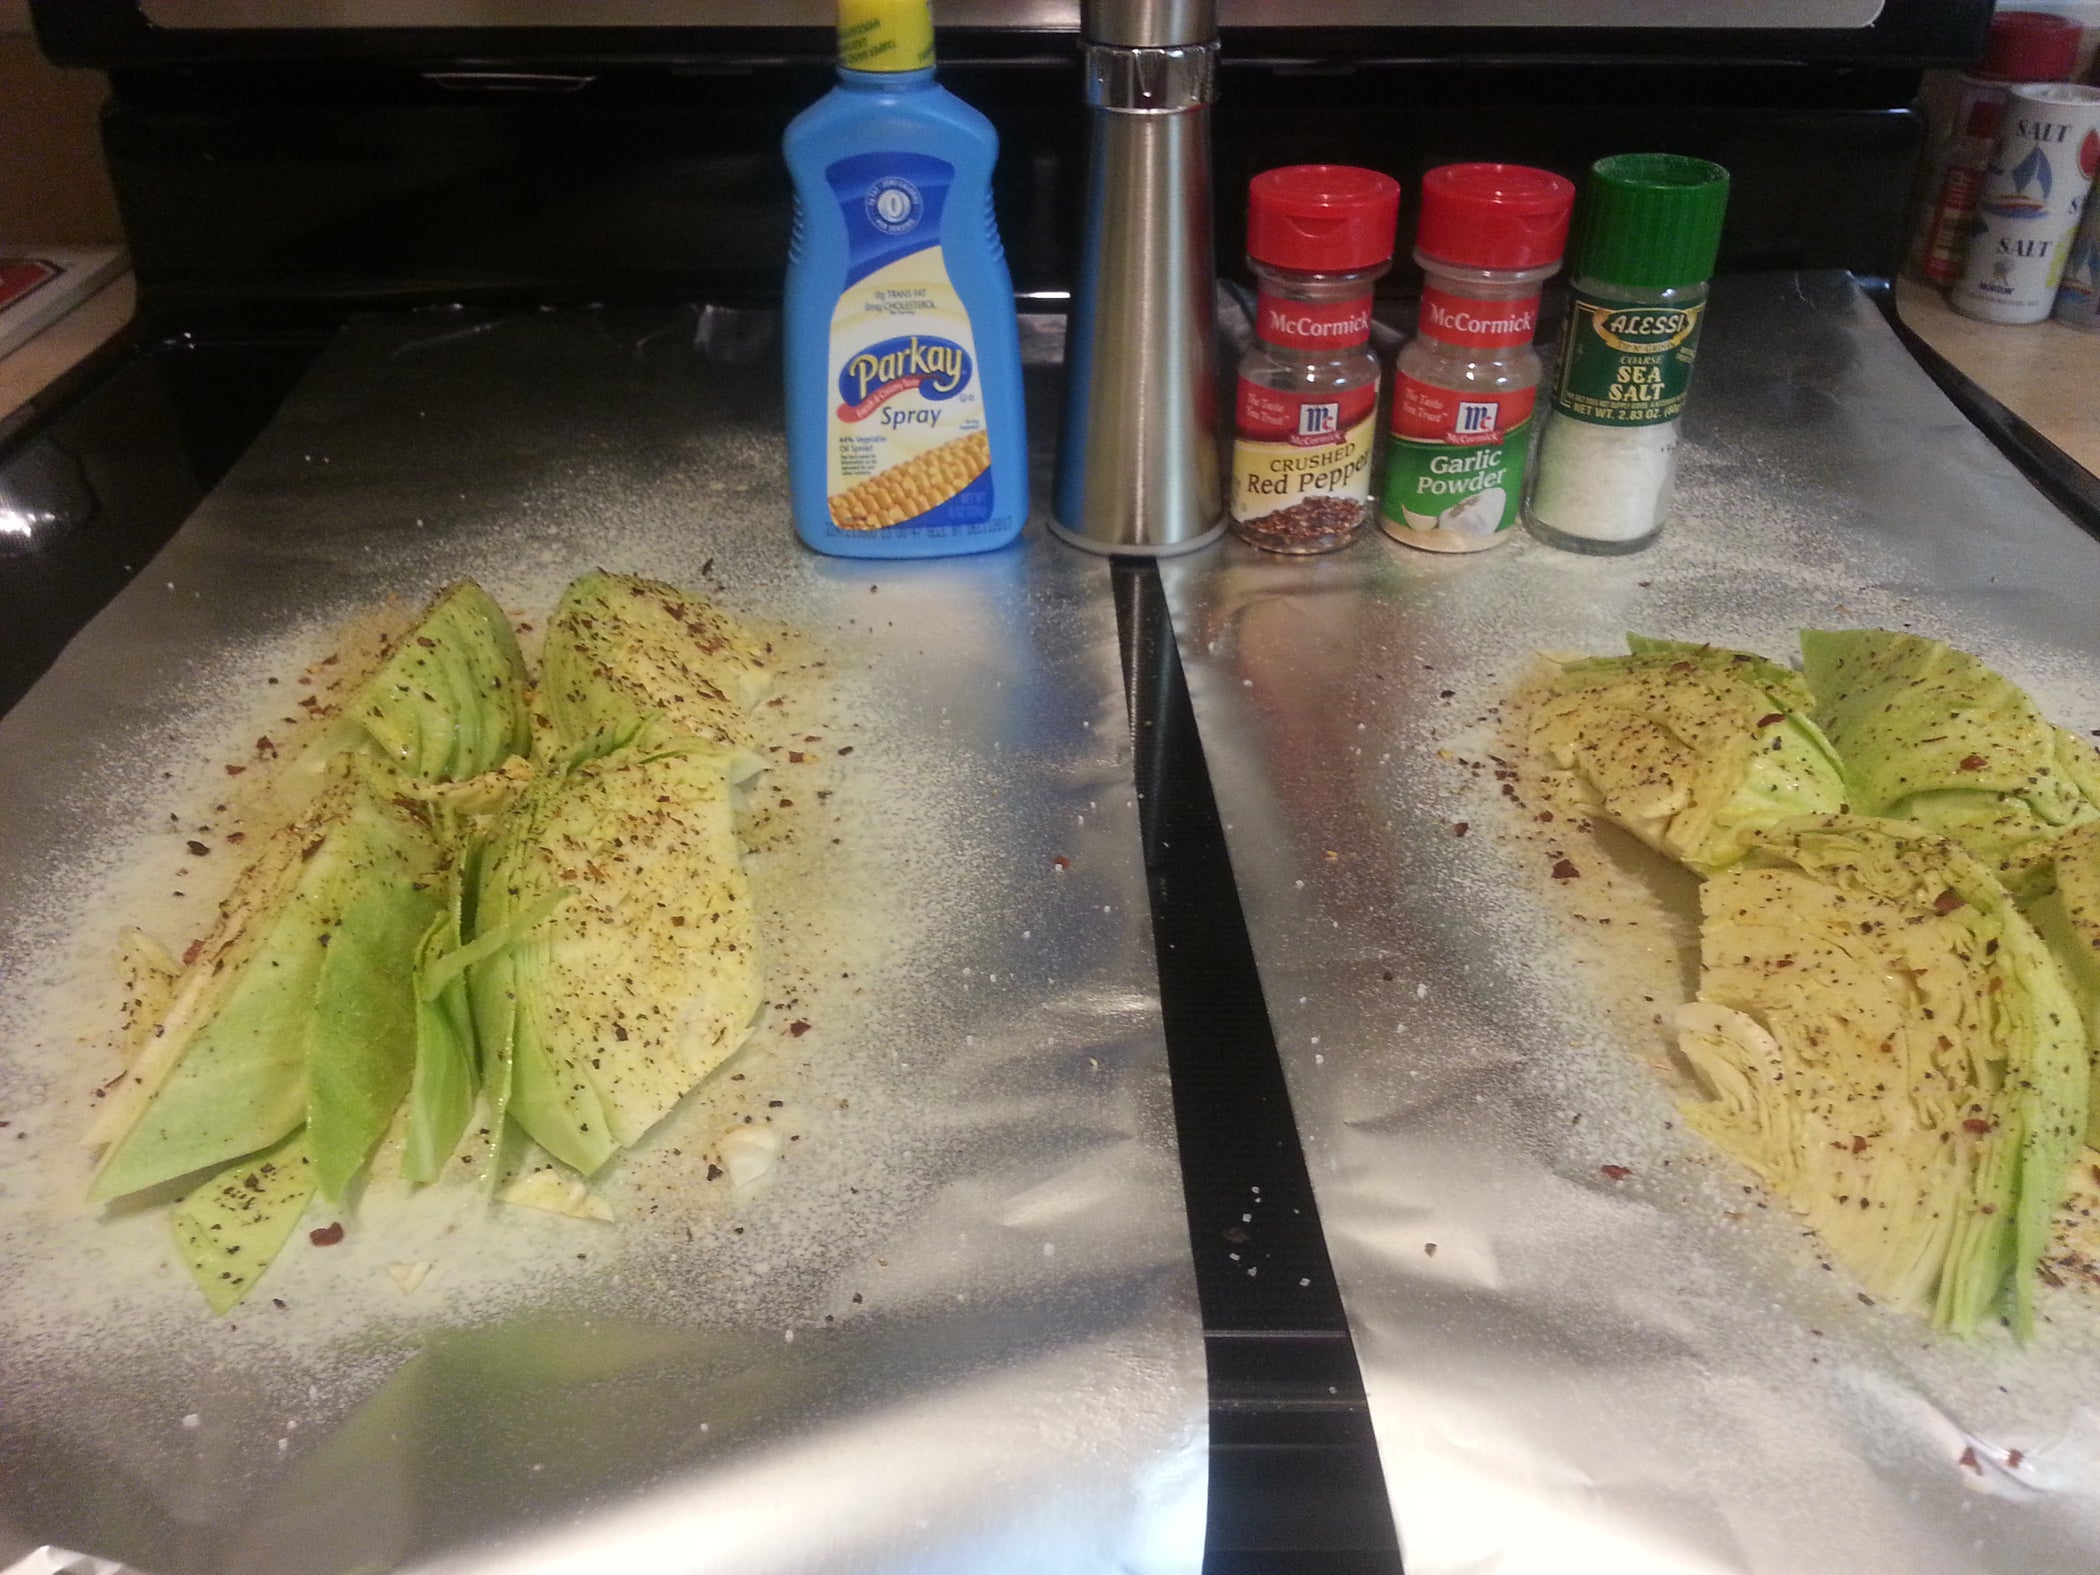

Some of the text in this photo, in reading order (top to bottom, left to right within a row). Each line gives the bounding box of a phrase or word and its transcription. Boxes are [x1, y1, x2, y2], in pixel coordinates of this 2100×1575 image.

[2016, 119, 2072, 143] SALT
[1997, 237, 2053, 259] SALT
[1269, 310, 1369, 336] McCormick
[1429, 303, 1532, 334] McCormick
[1610, 315, 1685, 335] ALESSI
[849, 337, 963, 401] Parkay
[1617, 366, 1662, 383] SEA
[1609, 384, 1665, 401] SALT
[881, 406, 942, 430] Spray
[1618, 410, 1644, 421] 2.83
[1269, 442, 1356, 474] CRUSHED
[1430, 448, 1502, 475] Garlic
[1247, 473, 1289, 495] Red
[1298, 450, 1370, 492] Pepper
[1417, 467, 1507, 495] Powder
